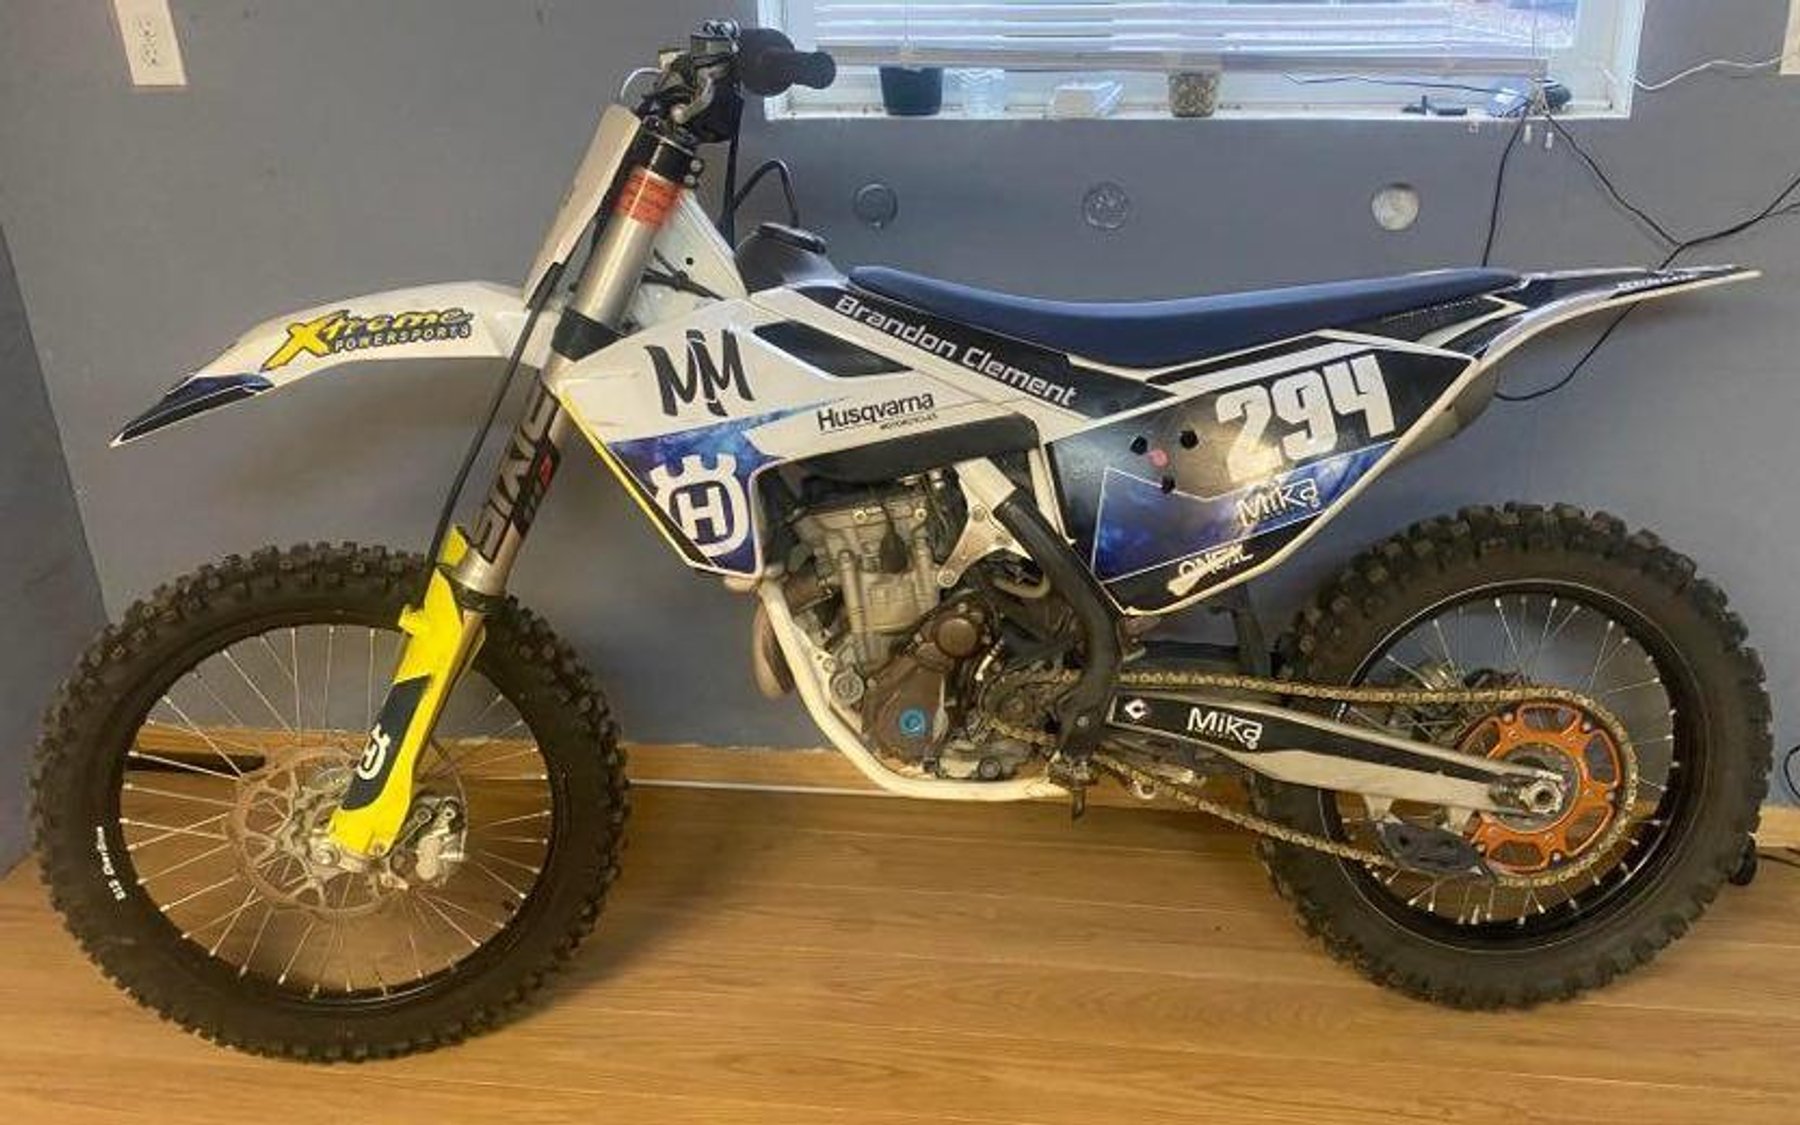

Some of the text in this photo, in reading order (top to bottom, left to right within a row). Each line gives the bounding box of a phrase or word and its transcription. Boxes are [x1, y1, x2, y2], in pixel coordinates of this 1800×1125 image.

[258, 308, 474, 372] Xtreme
[334, 322, 472, 353] POWERSPORTS
[835, 294, 1078, 406] Brandon Clement
[817, 393, 934, 431] Husqvarna
[1215, 354, 1395, 484] 294
[1236, 478, 1322, 527] Mika
[1187, 707, 1263, 750] Mika
